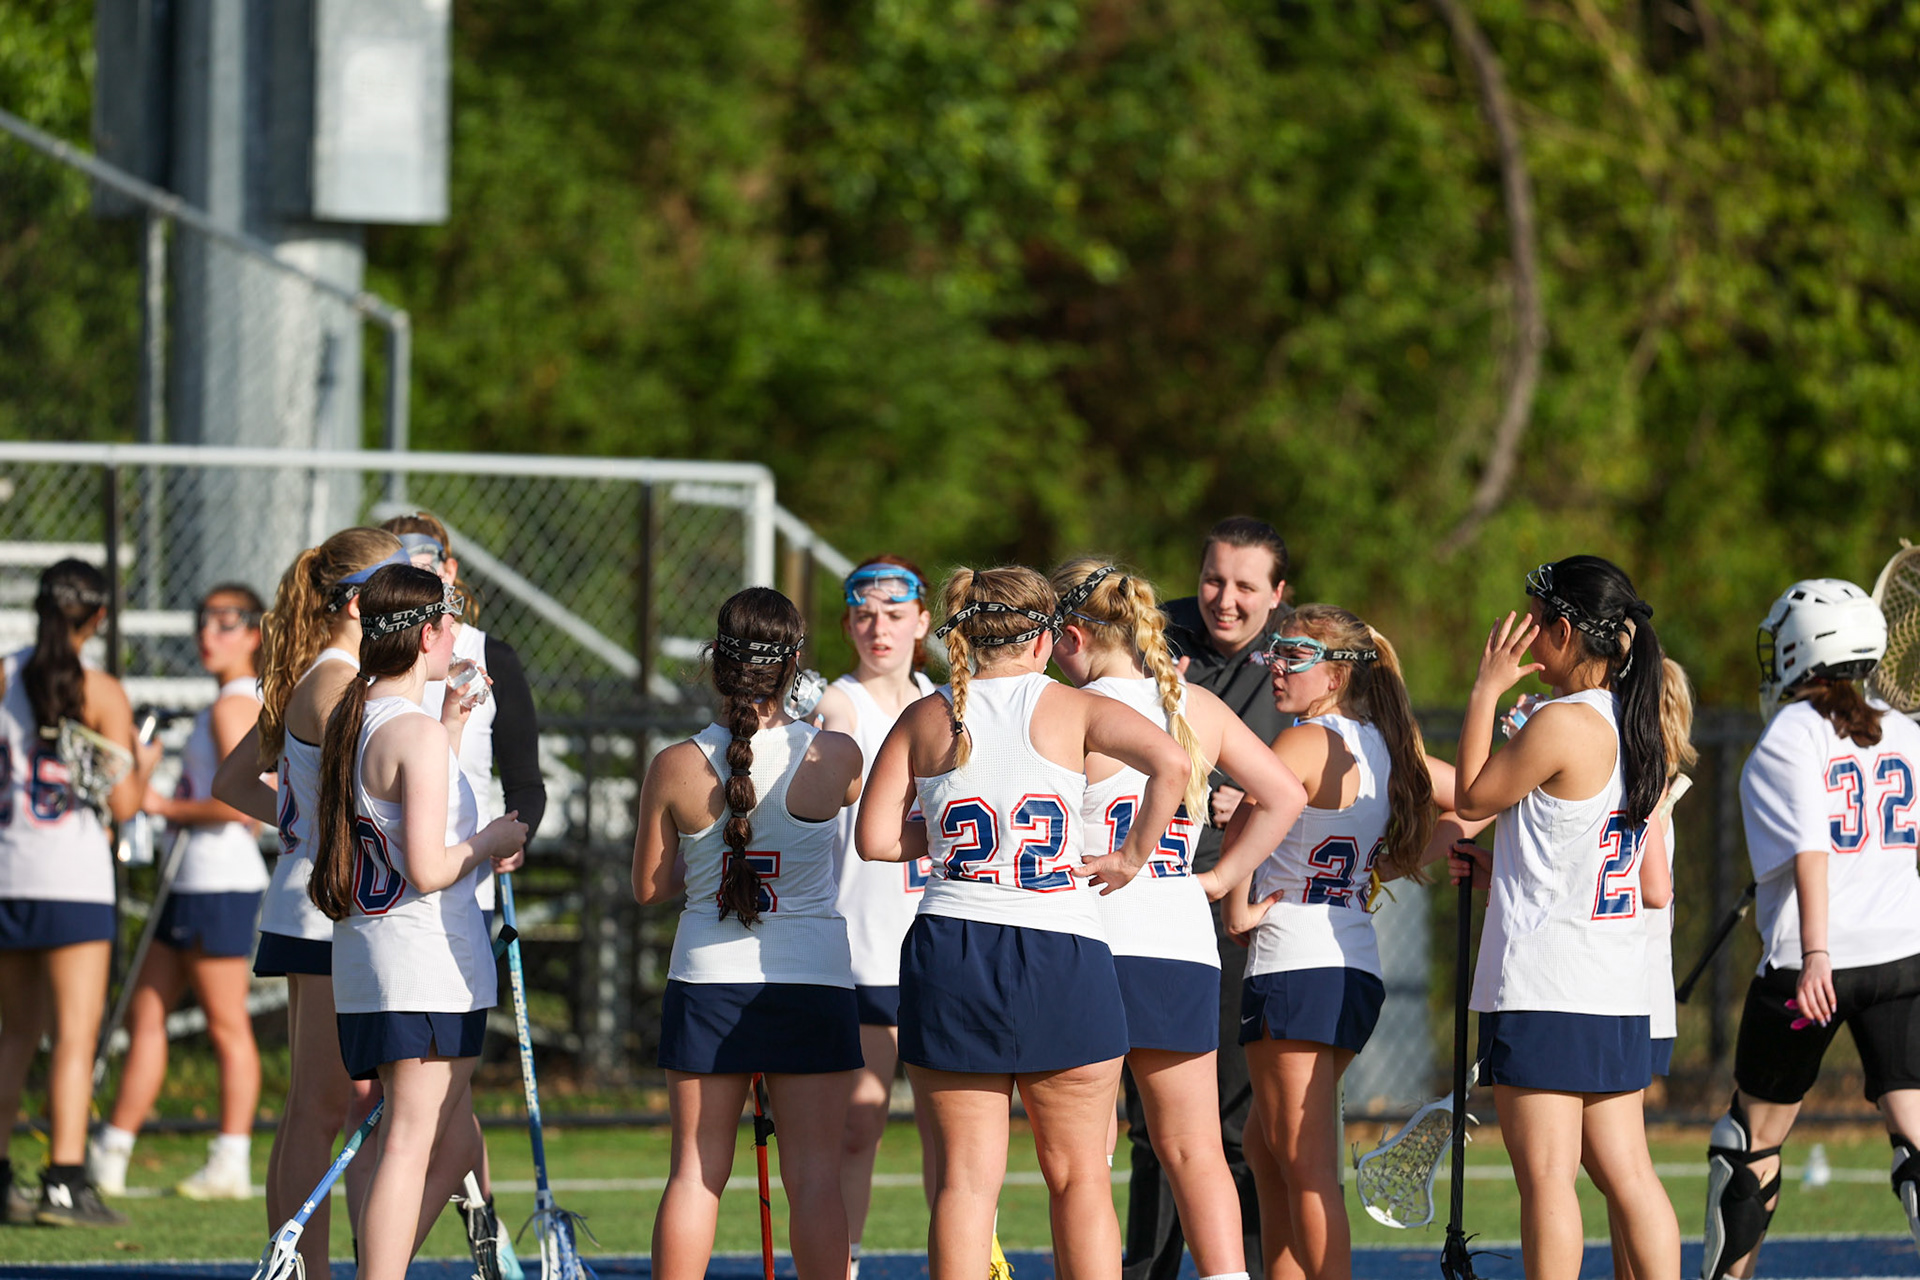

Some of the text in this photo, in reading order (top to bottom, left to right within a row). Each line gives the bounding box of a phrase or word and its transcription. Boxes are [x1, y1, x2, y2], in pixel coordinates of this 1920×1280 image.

[392, 608, 419, 622] STX
[956, 603, 981, 622] STX
[1028, 610, 1049, 625] STX
[385, 619, 411, 634] STX
[1015, 627, 1041, 643] STX
[749, 642, 780, 655] STX
[1332, 651, 1358, 660] STX
[750, 655, 783, 665] STX
[1824, 752, 1918, 854] 32
[940, 793, 1077, 893] 22
